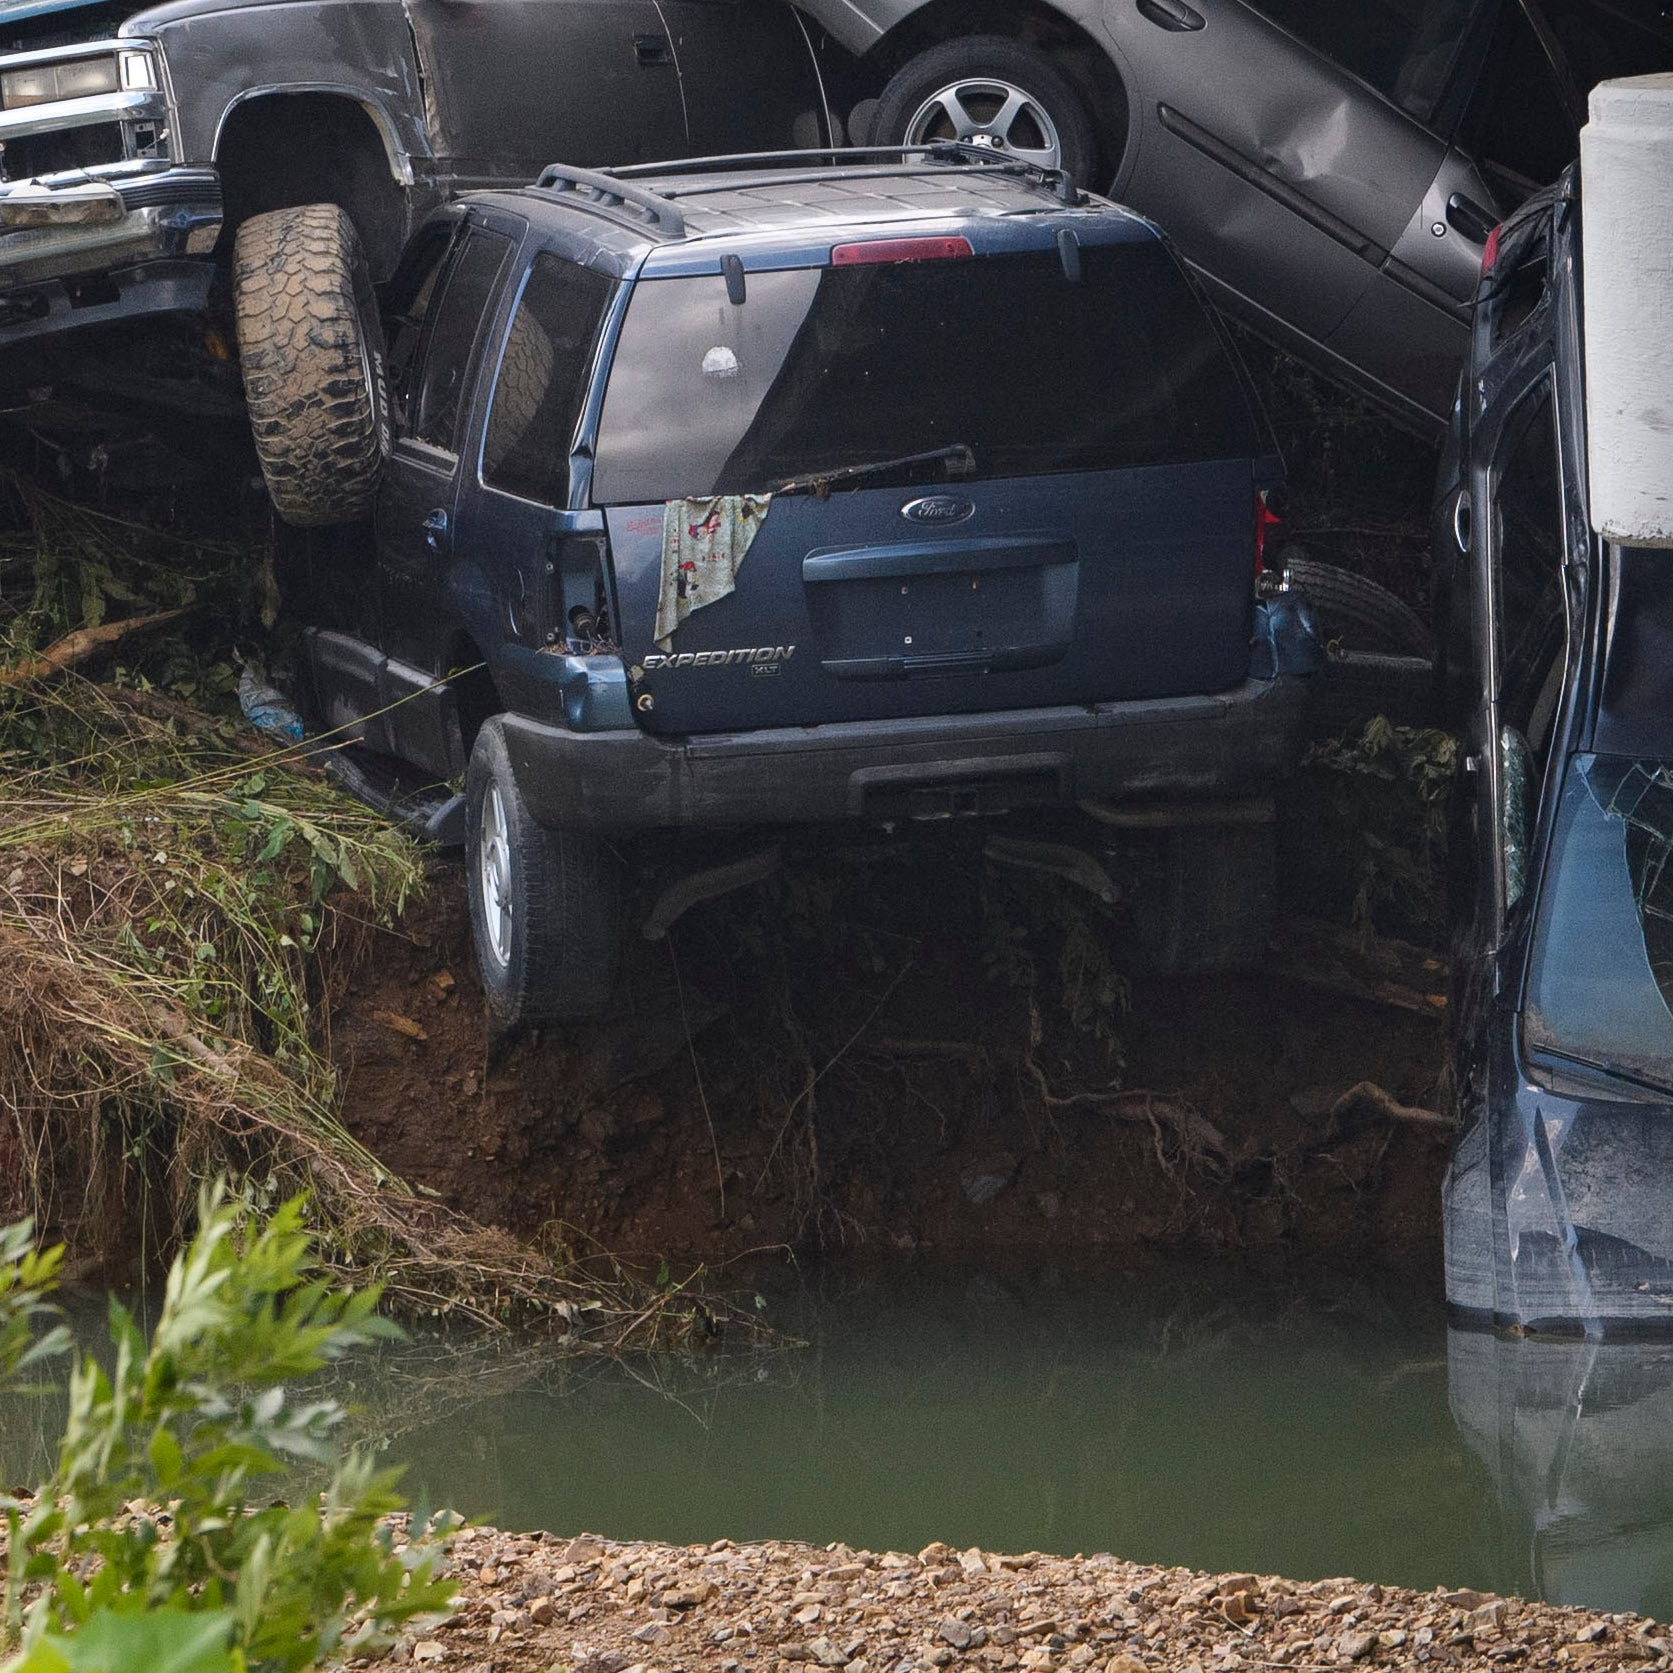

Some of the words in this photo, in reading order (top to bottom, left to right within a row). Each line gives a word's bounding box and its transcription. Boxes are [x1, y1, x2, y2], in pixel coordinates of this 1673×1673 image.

[917, 501, 957, 518] Ford
[642, 645, 796, 669] EXPEDITION
[754, 665, 778, 674] XLT
